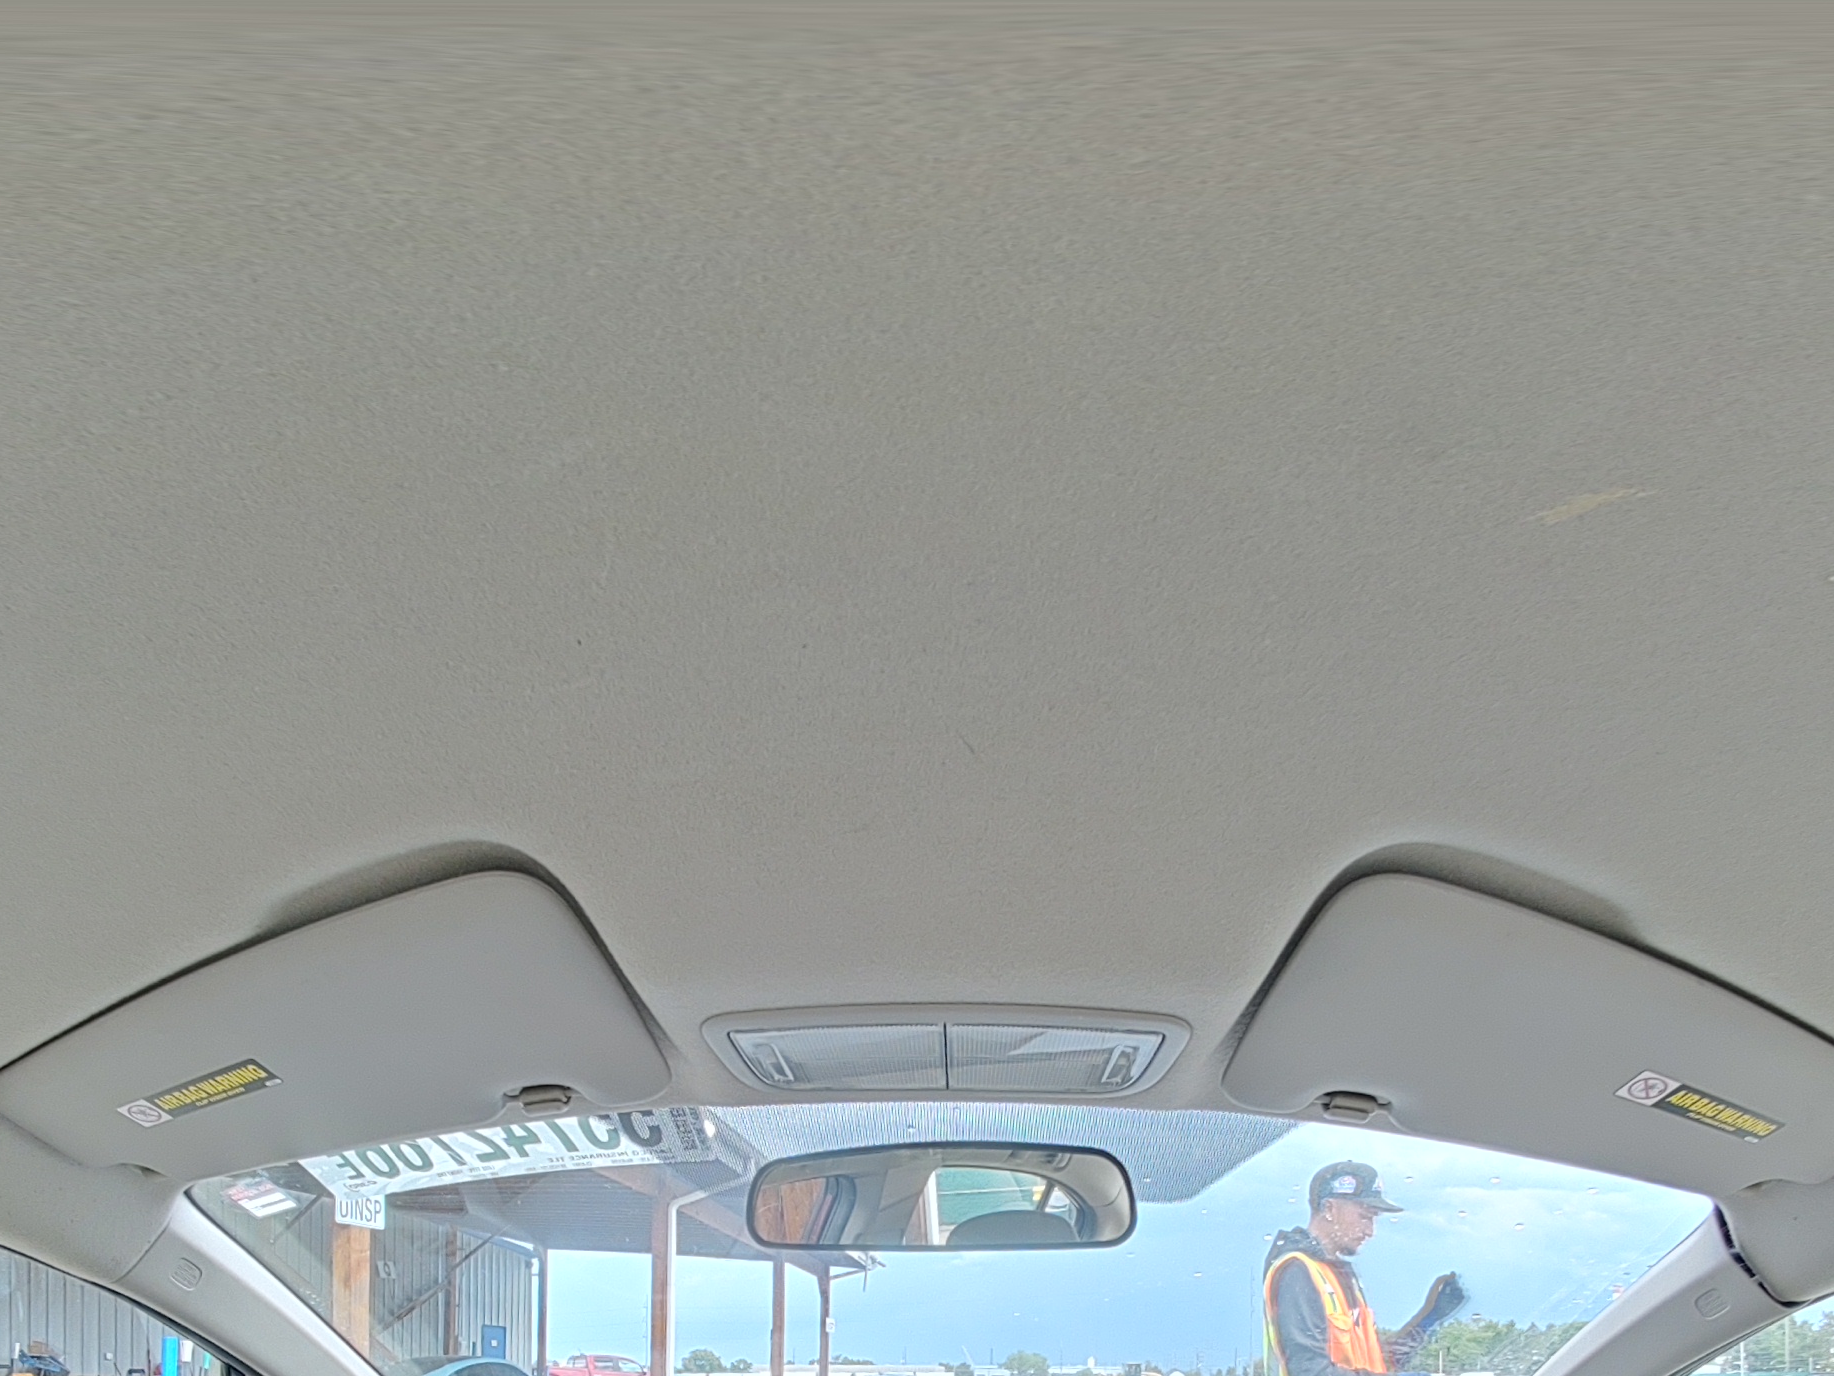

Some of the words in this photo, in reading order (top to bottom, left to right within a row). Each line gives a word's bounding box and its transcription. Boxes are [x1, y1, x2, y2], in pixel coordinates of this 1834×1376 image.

[154, 1085, 208, 1111] AIRBAG
[196, 1064, 268, 1096] WARNING
[1665, 1090, 1726, 1117] AIRBAG
[1714, 1105, 1778, 1136] WARNING
